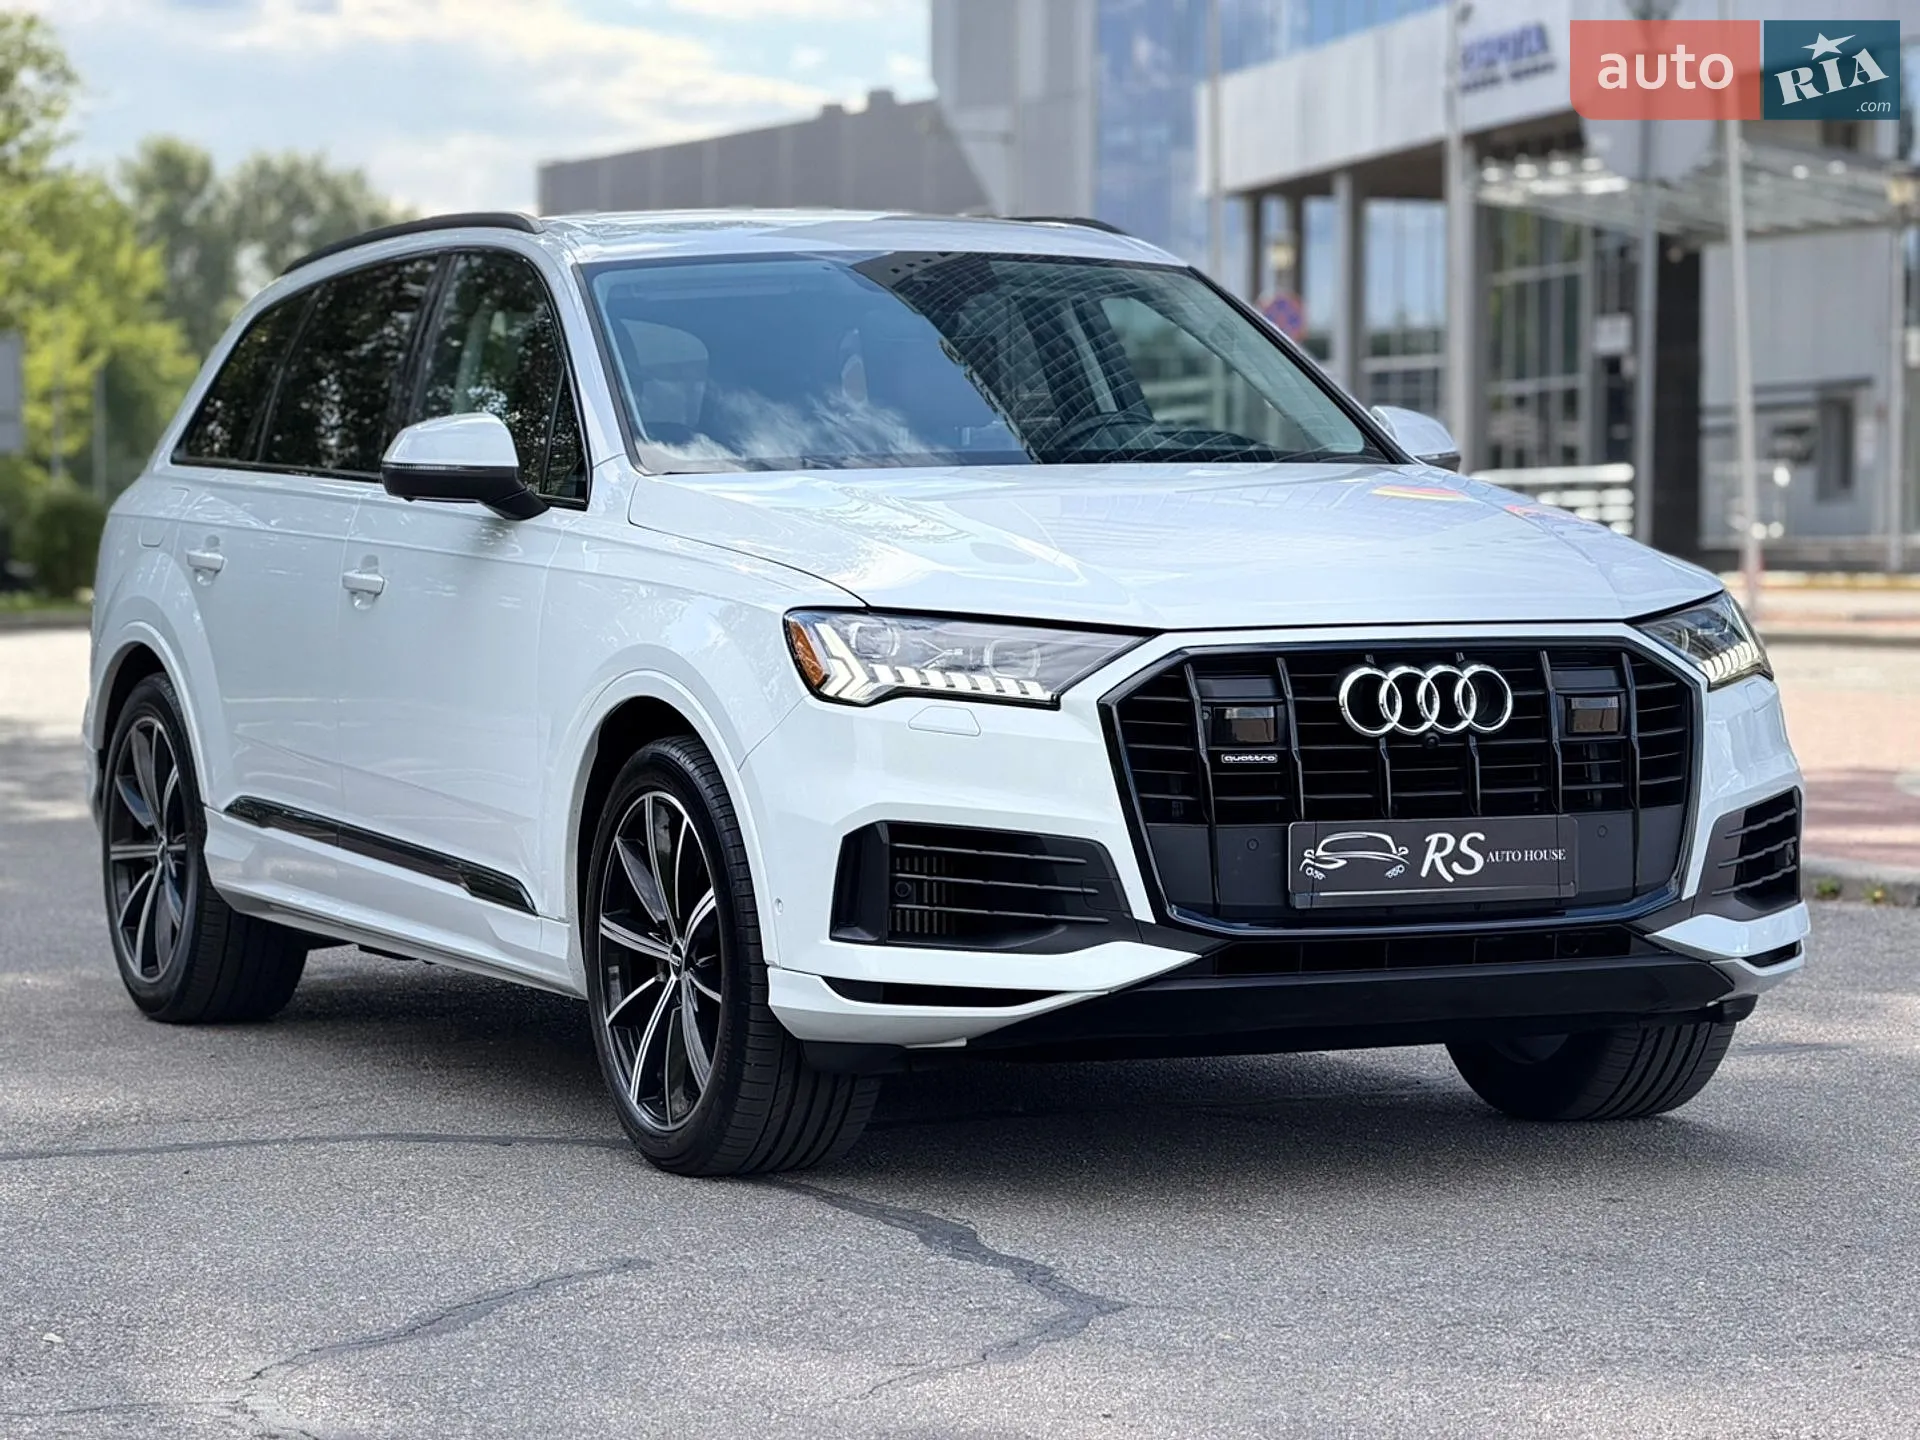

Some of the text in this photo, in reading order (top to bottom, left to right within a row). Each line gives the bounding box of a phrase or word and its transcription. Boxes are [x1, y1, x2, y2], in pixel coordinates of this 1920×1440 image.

[1223, 754, 1277, 763] quattro
[1420, 832, 1566, 882] RS AUTO HOUSE
